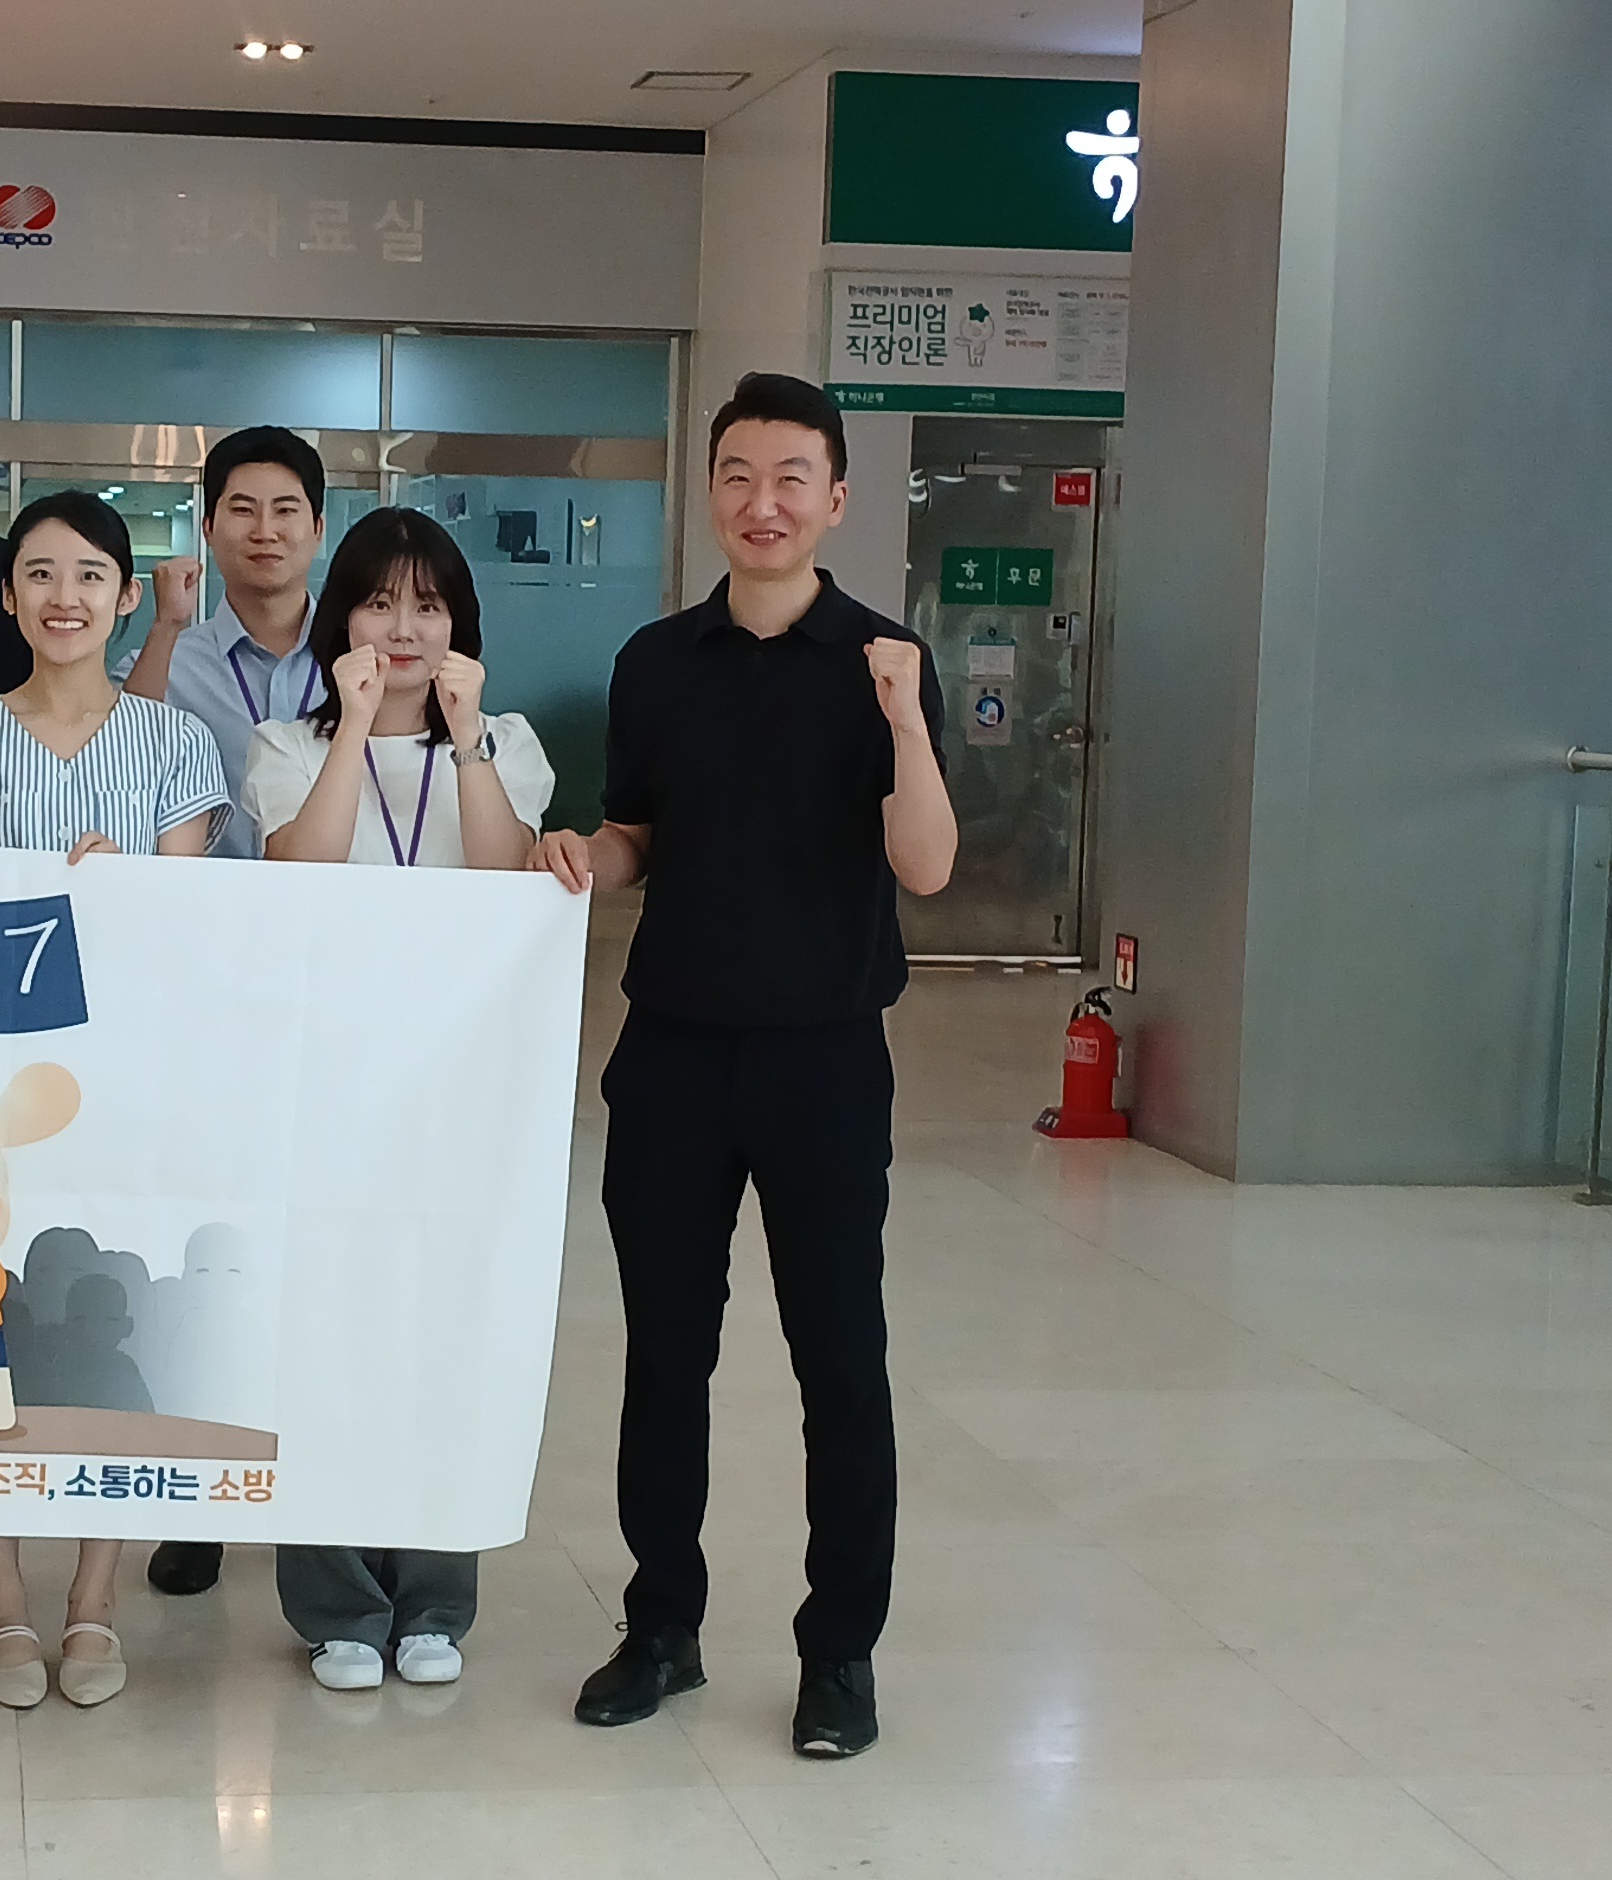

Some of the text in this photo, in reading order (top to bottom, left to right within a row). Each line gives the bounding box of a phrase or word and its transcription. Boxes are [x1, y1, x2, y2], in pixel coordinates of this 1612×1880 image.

[846, 302, 947, 335] 프리미엄
[845, 334, 948, 367] 직장인론
[63, 1463, 201, 1502] 소통하는
[208, 1468, 276, 1504] 소방
